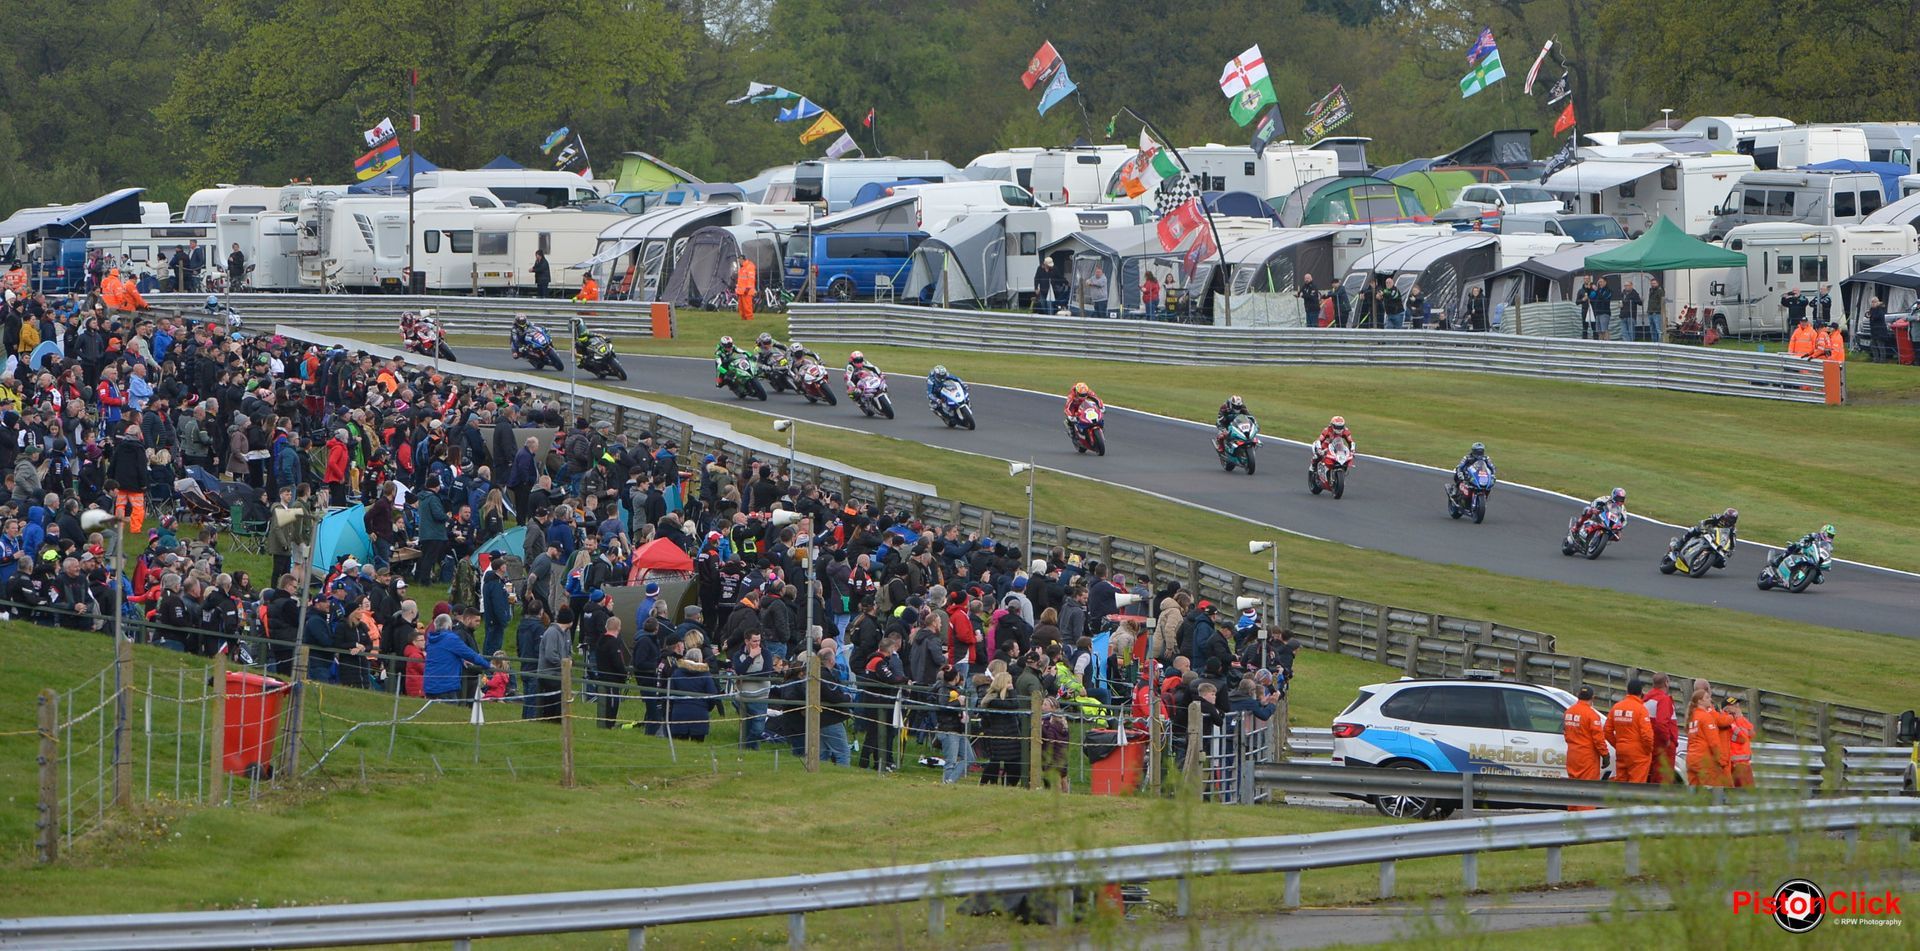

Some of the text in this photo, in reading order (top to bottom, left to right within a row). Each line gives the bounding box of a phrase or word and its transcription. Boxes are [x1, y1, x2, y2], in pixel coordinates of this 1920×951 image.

[1468, 743, 1568, 766] Medical Ca
[1480, 766, 1512, 777] Official
